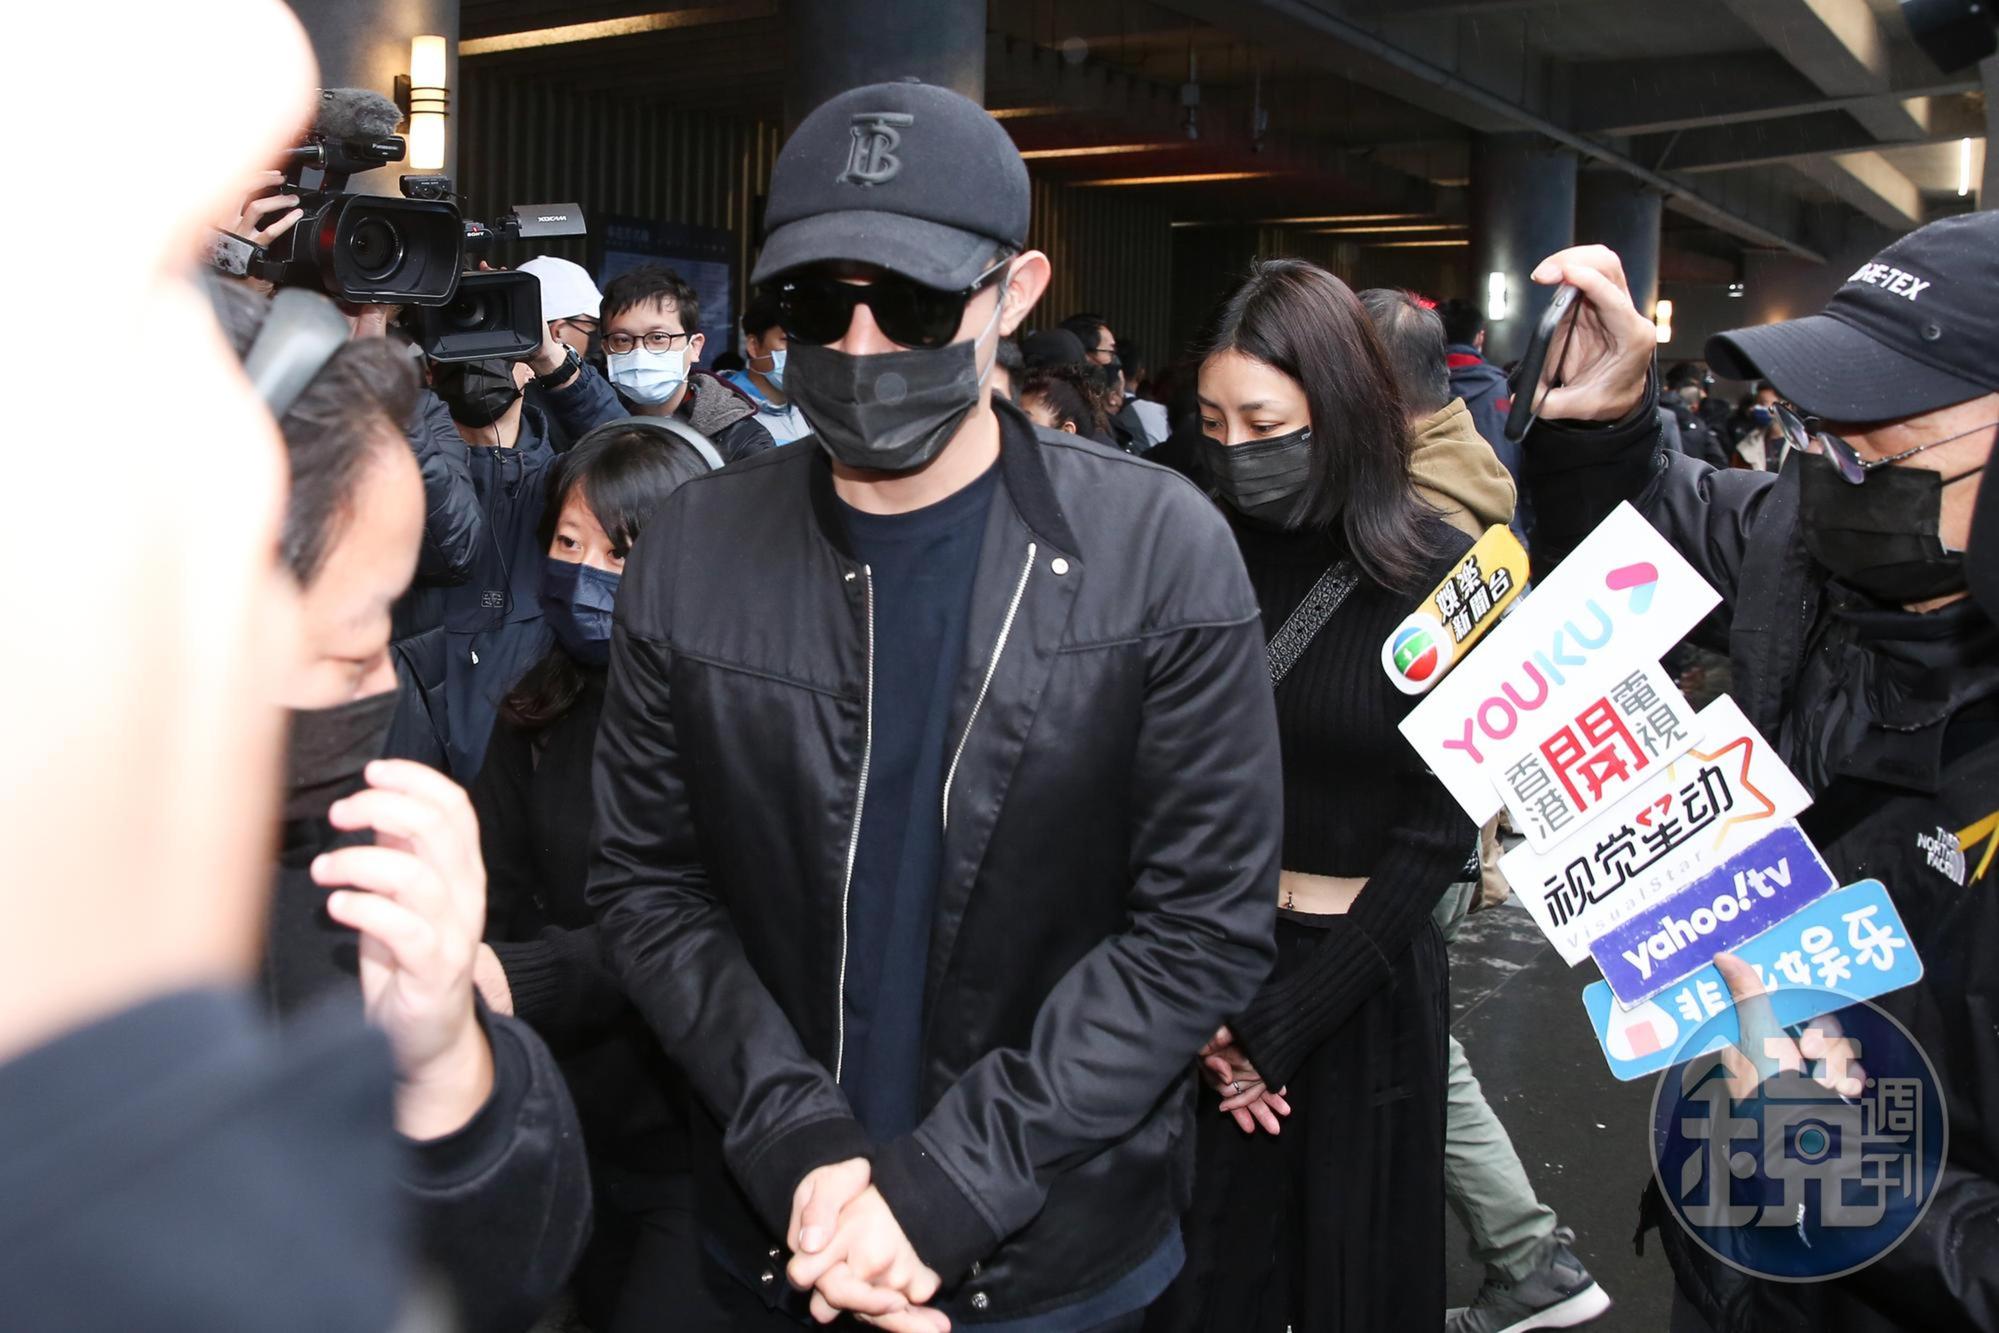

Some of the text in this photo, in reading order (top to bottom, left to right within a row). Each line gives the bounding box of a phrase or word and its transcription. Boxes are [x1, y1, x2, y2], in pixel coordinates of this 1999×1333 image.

[1443, 599, 1613, 764] YOUKU
[1917, 832, 1953, 861] NORTH
[1927, 852, 1954, 875] FACE
[1675, 904, 1906, 1022] 非娱乐
